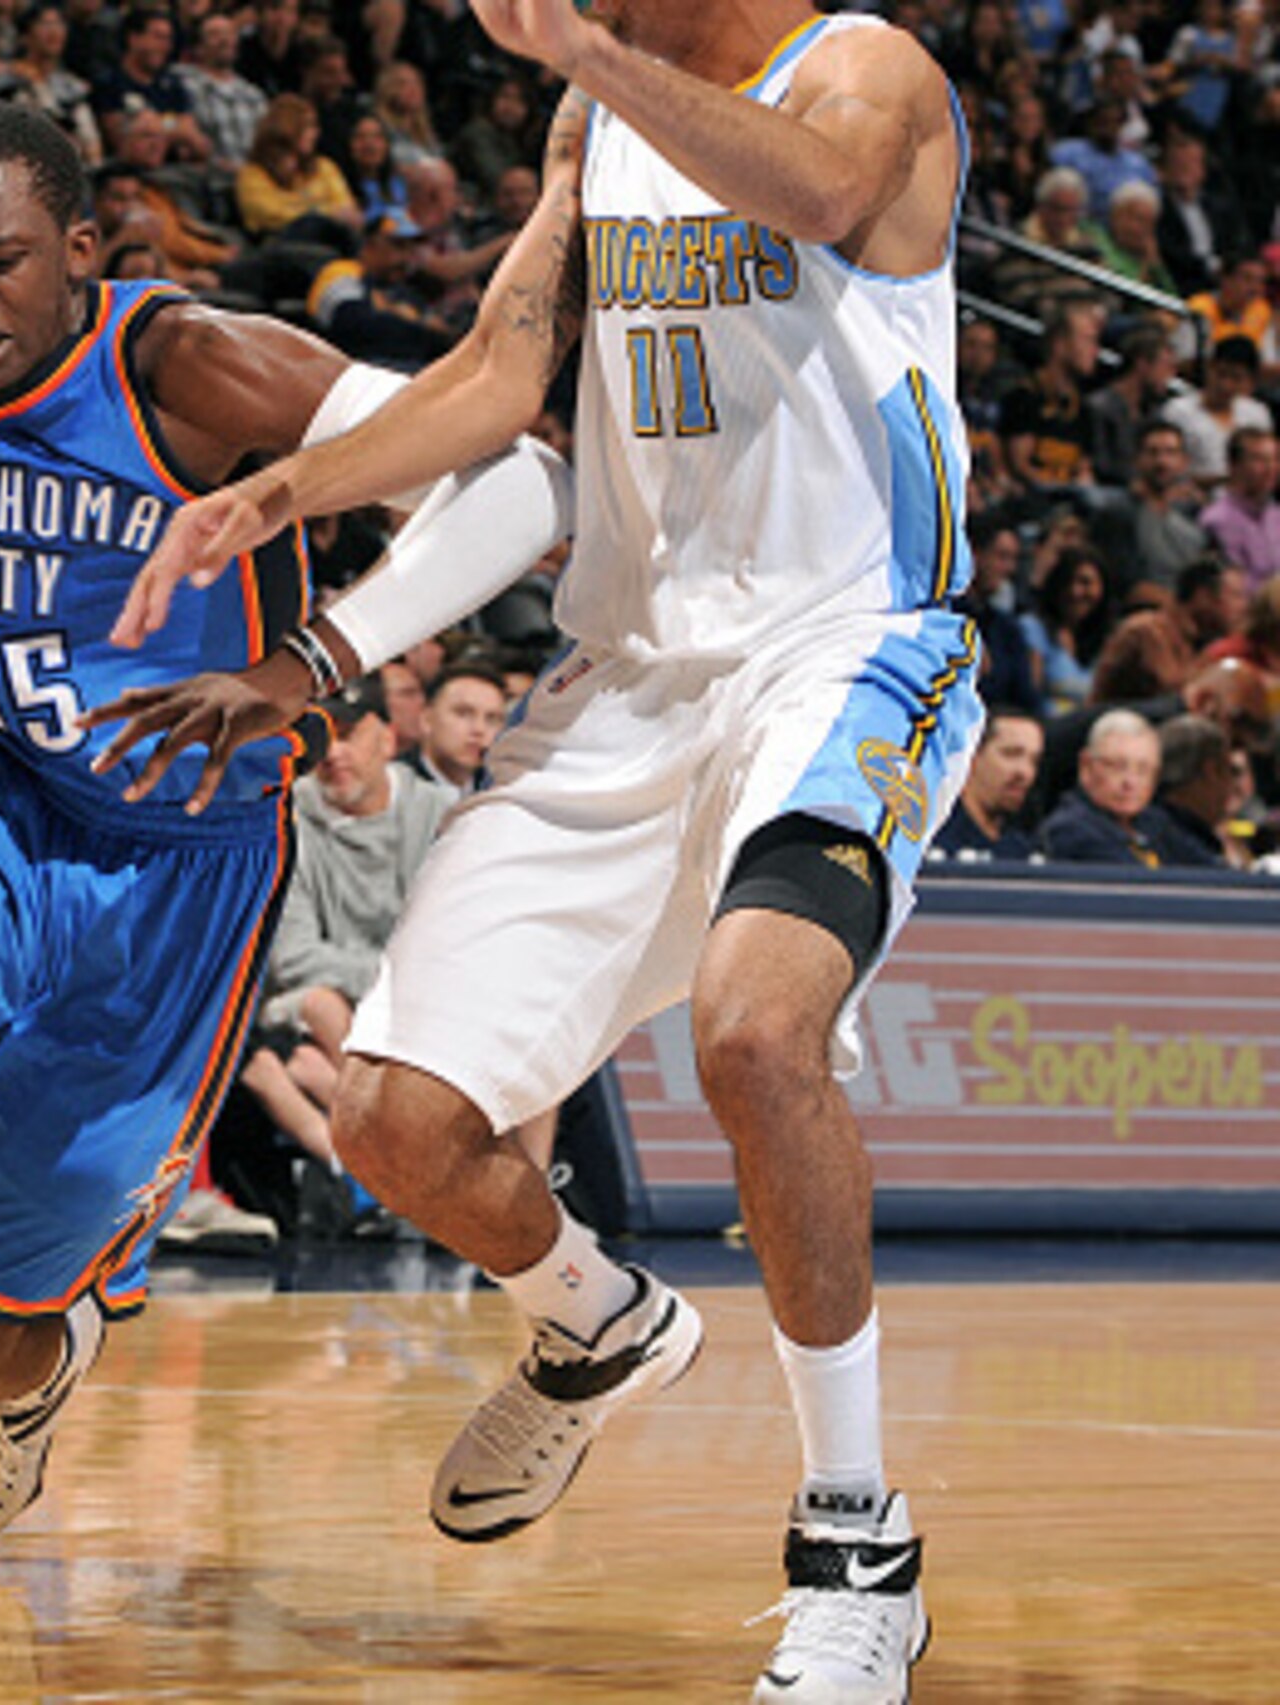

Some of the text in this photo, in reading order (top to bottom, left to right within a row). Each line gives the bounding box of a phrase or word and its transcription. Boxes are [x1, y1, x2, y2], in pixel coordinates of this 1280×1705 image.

[583, 216, 800, 310] UGGETS
[626, 324, 719, 438] 11
[970, 993, 1263, 1140] Soopers
